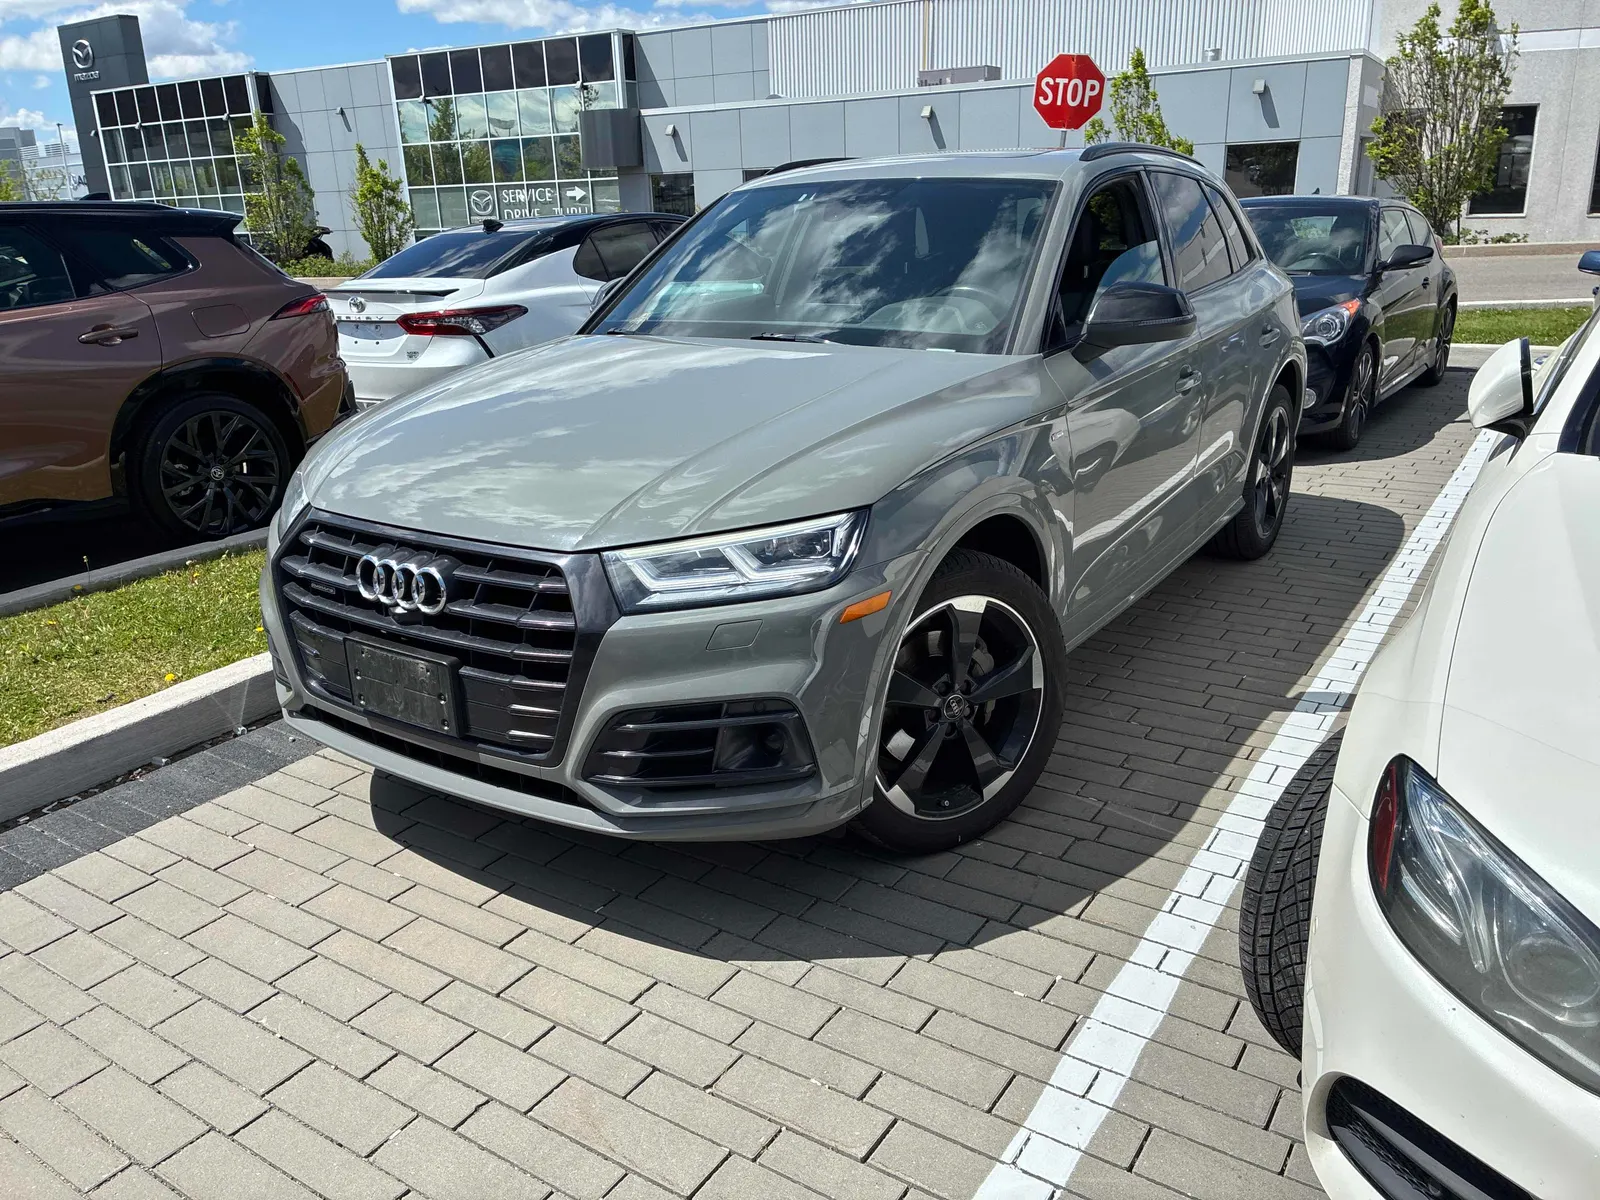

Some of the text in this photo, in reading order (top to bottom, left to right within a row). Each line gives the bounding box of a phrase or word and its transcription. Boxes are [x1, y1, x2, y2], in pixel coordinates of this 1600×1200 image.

[1039, 77, 1100, 107] STOP
[502, 188, 553, 203] SERVICE
[504, 208, 541, 220] DRIVE
